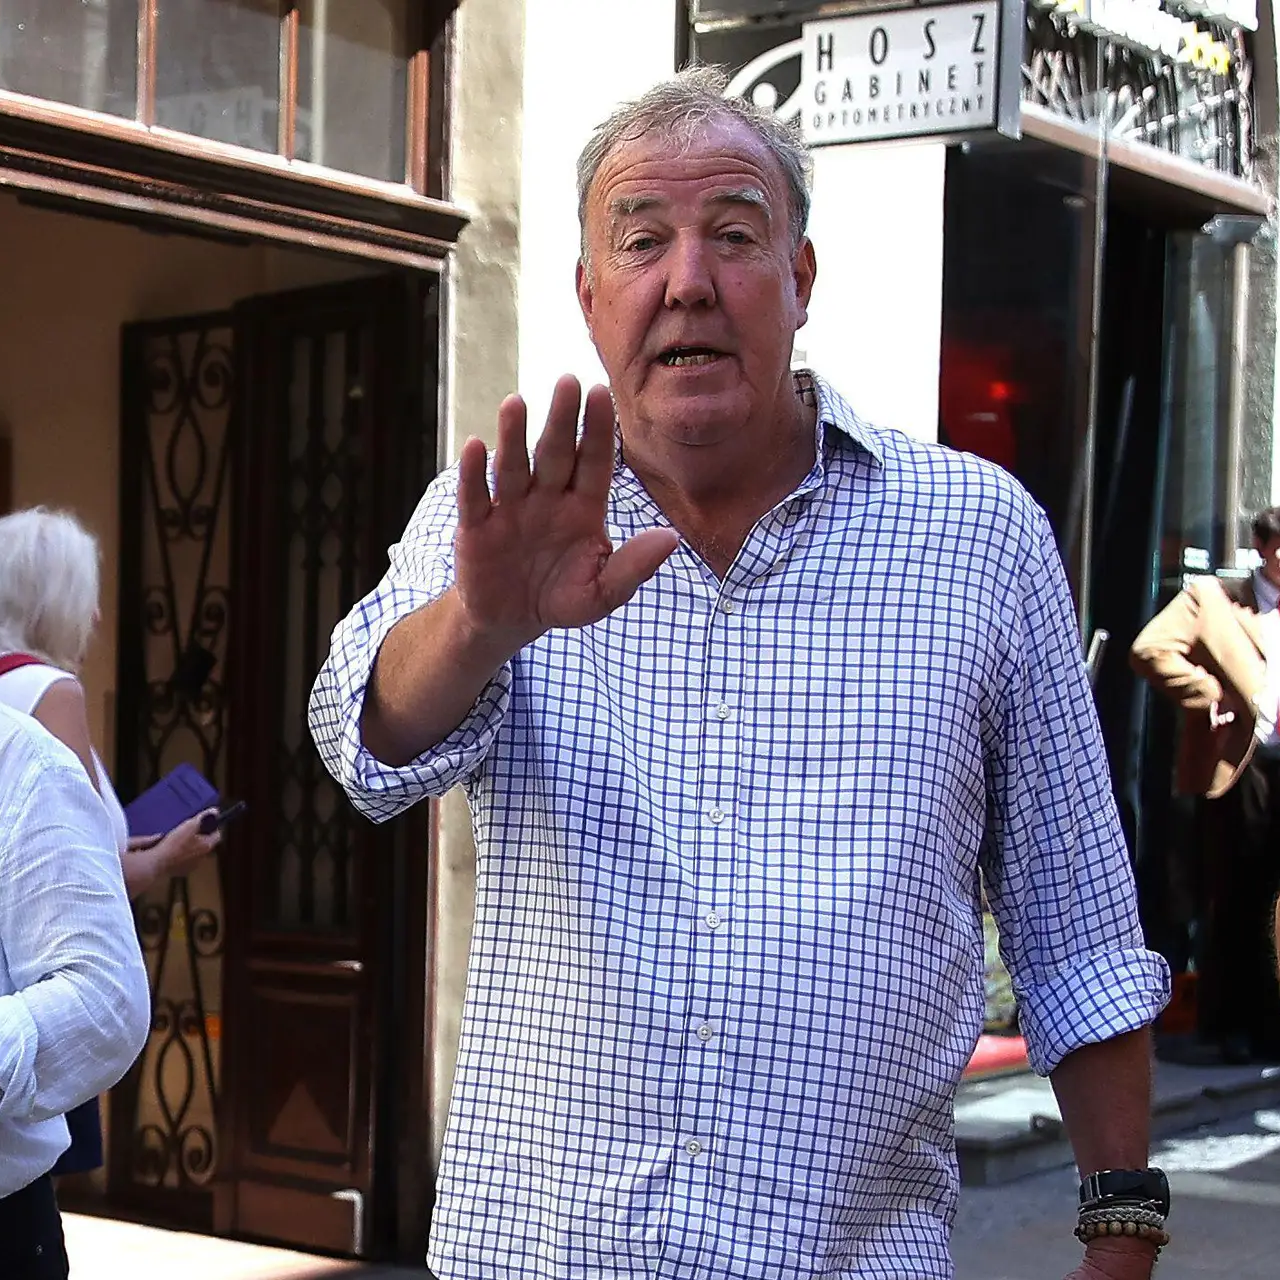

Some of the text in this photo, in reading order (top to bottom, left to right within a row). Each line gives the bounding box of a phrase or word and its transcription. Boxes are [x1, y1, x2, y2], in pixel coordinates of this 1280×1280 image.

[816, 13, 985, 72] HOSZ
[813, 61, 984, 105] GABINET
[813, 95, 983, 129] OPTOMETRYCZNY
